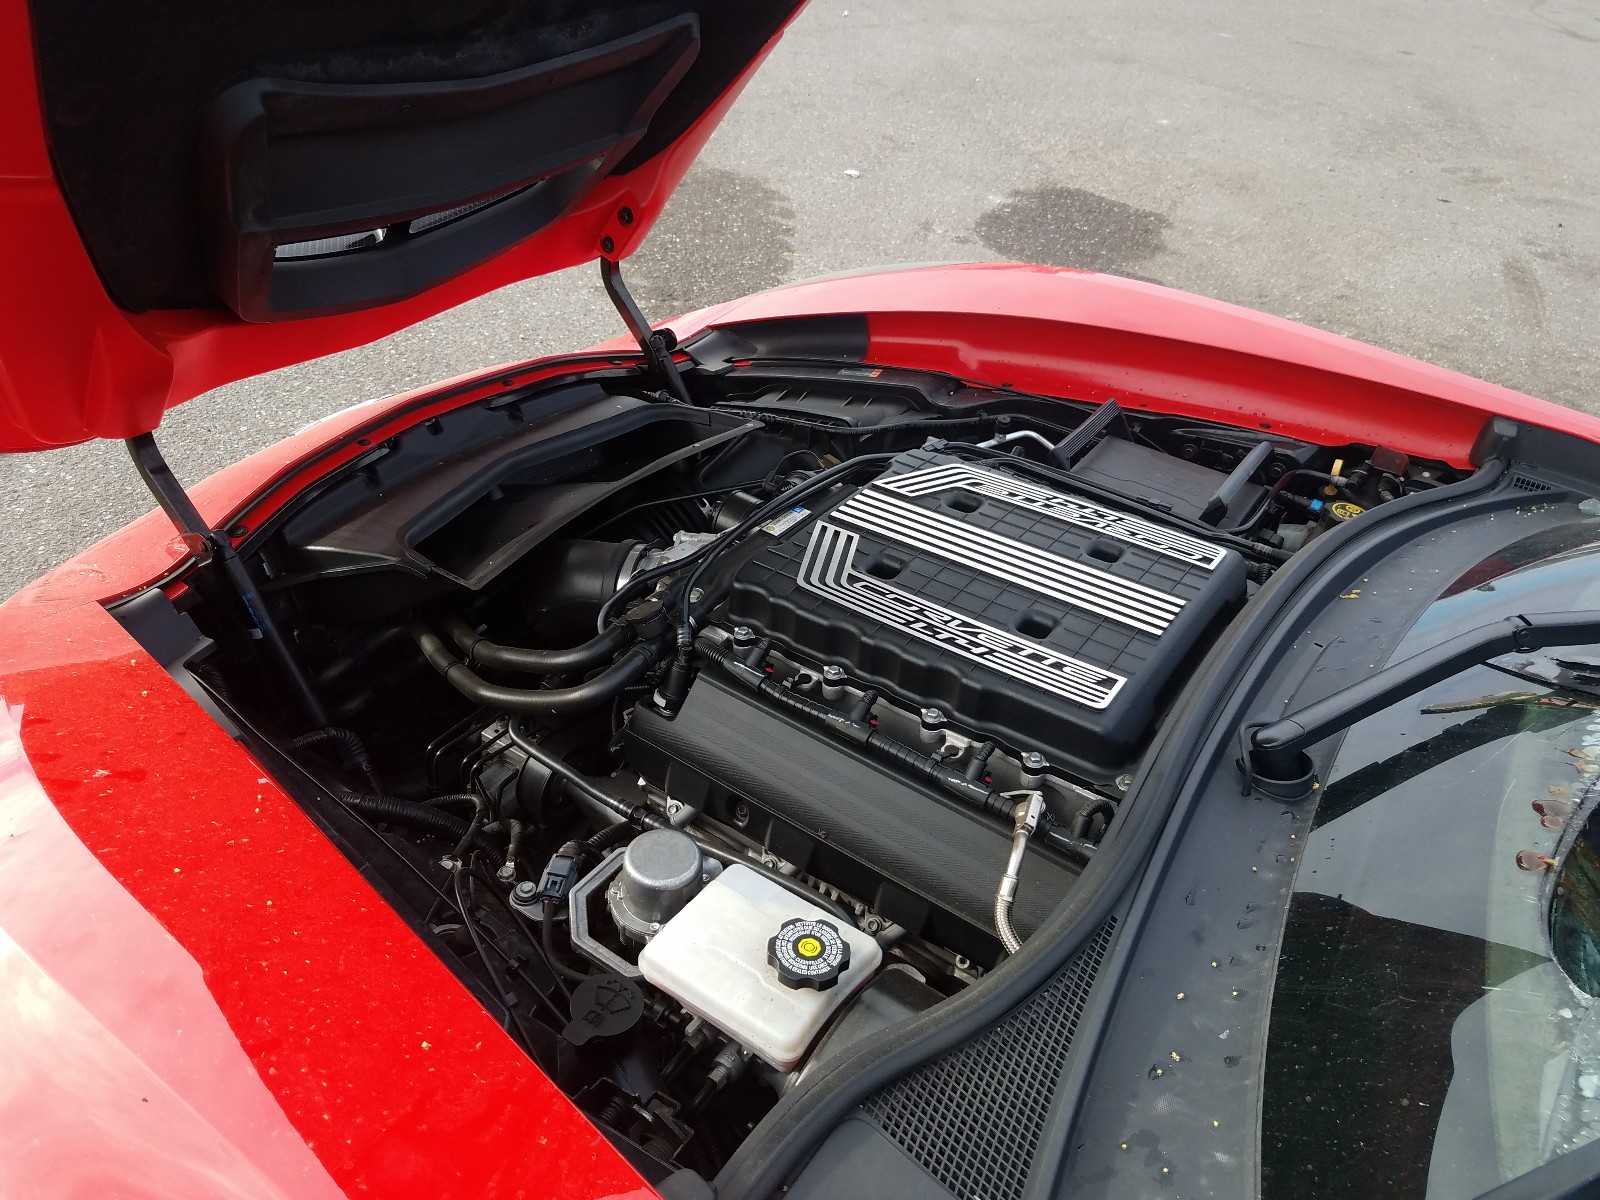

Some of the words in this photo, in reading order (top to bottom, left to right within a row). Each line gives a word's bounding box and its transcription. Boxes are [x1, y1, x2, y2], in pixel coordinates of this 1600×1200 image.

[973, 484, 1203, 560] CORVETTE
[853, 581, 1108, 683] CORVETTE
[909, 621, 990, 654] LT4
